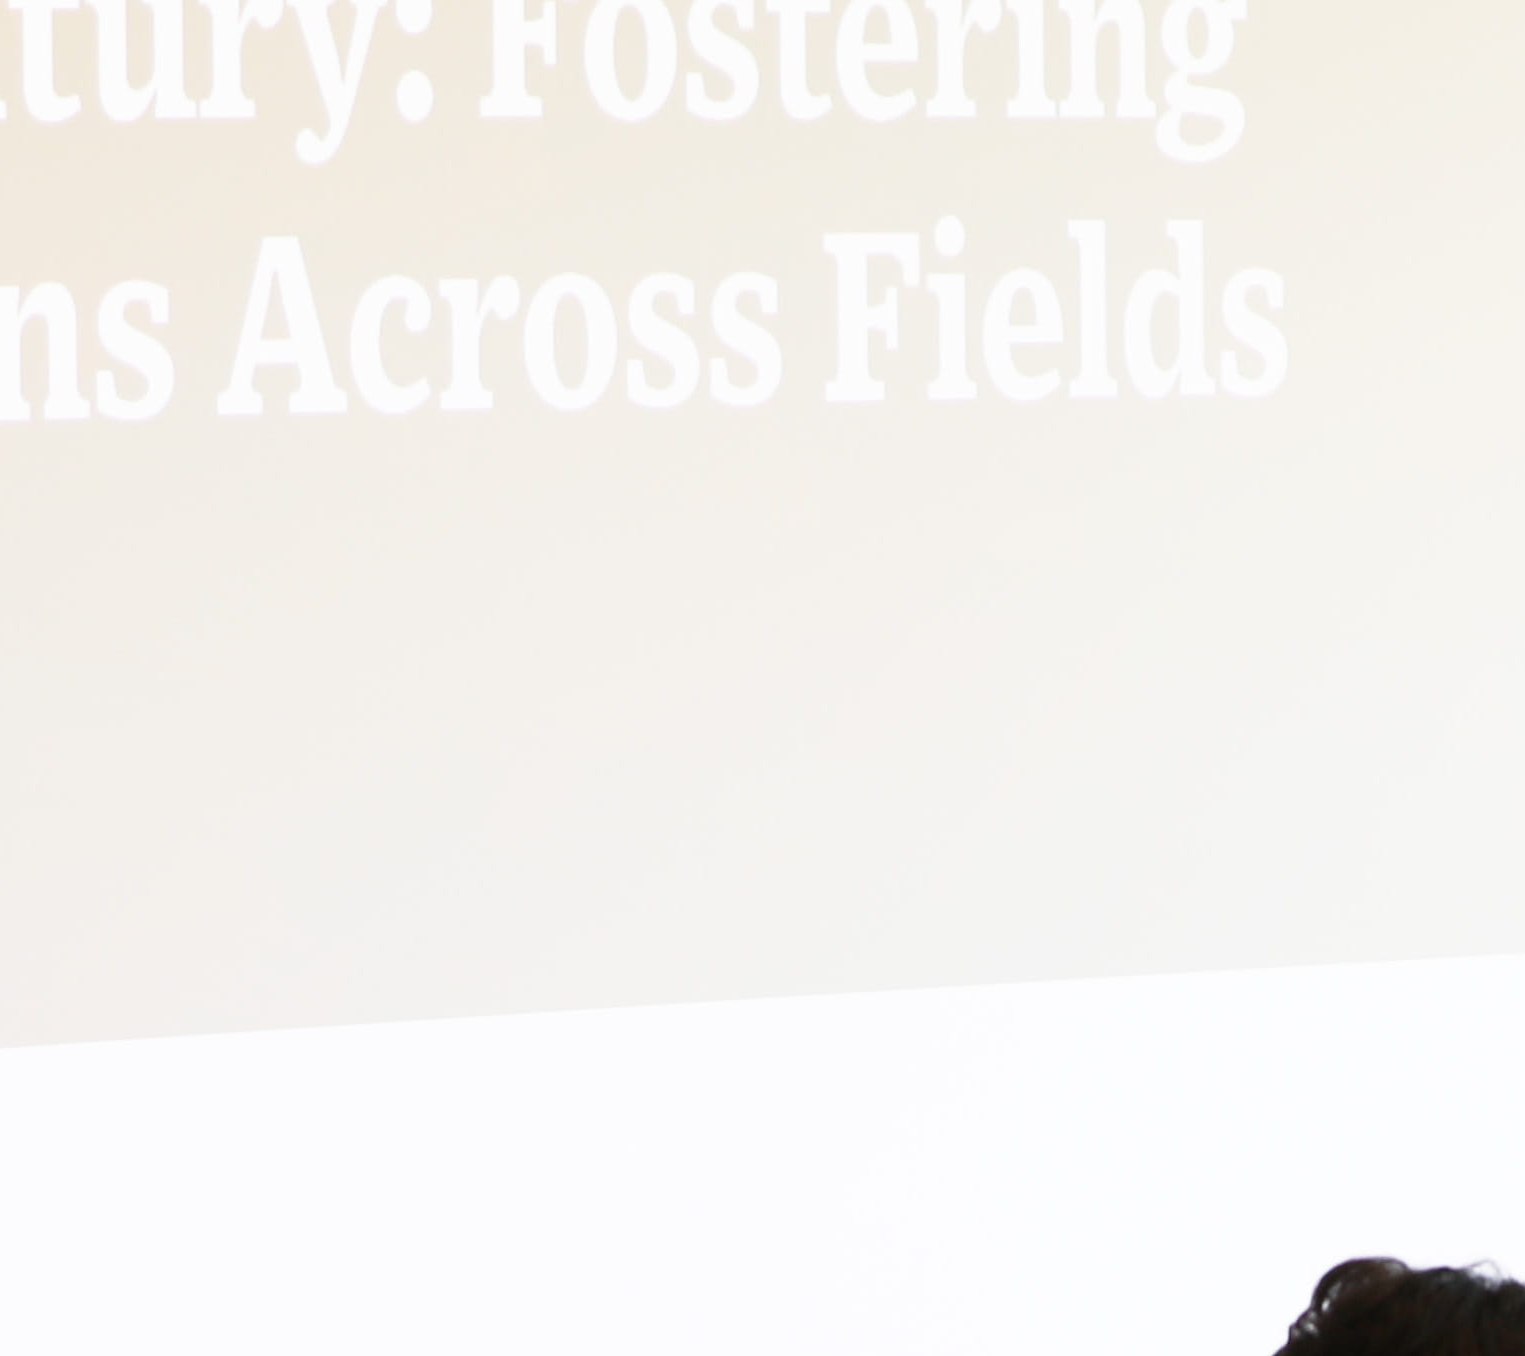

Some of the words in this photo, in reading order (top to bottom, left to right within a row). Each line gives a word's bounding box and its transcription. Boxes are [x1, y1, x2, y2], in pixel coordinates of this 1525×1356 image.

[480, 0, 1248, 165] Fostering
[216, 237, 782, 417] Across
[823, 215, 1289, 403] Fields
